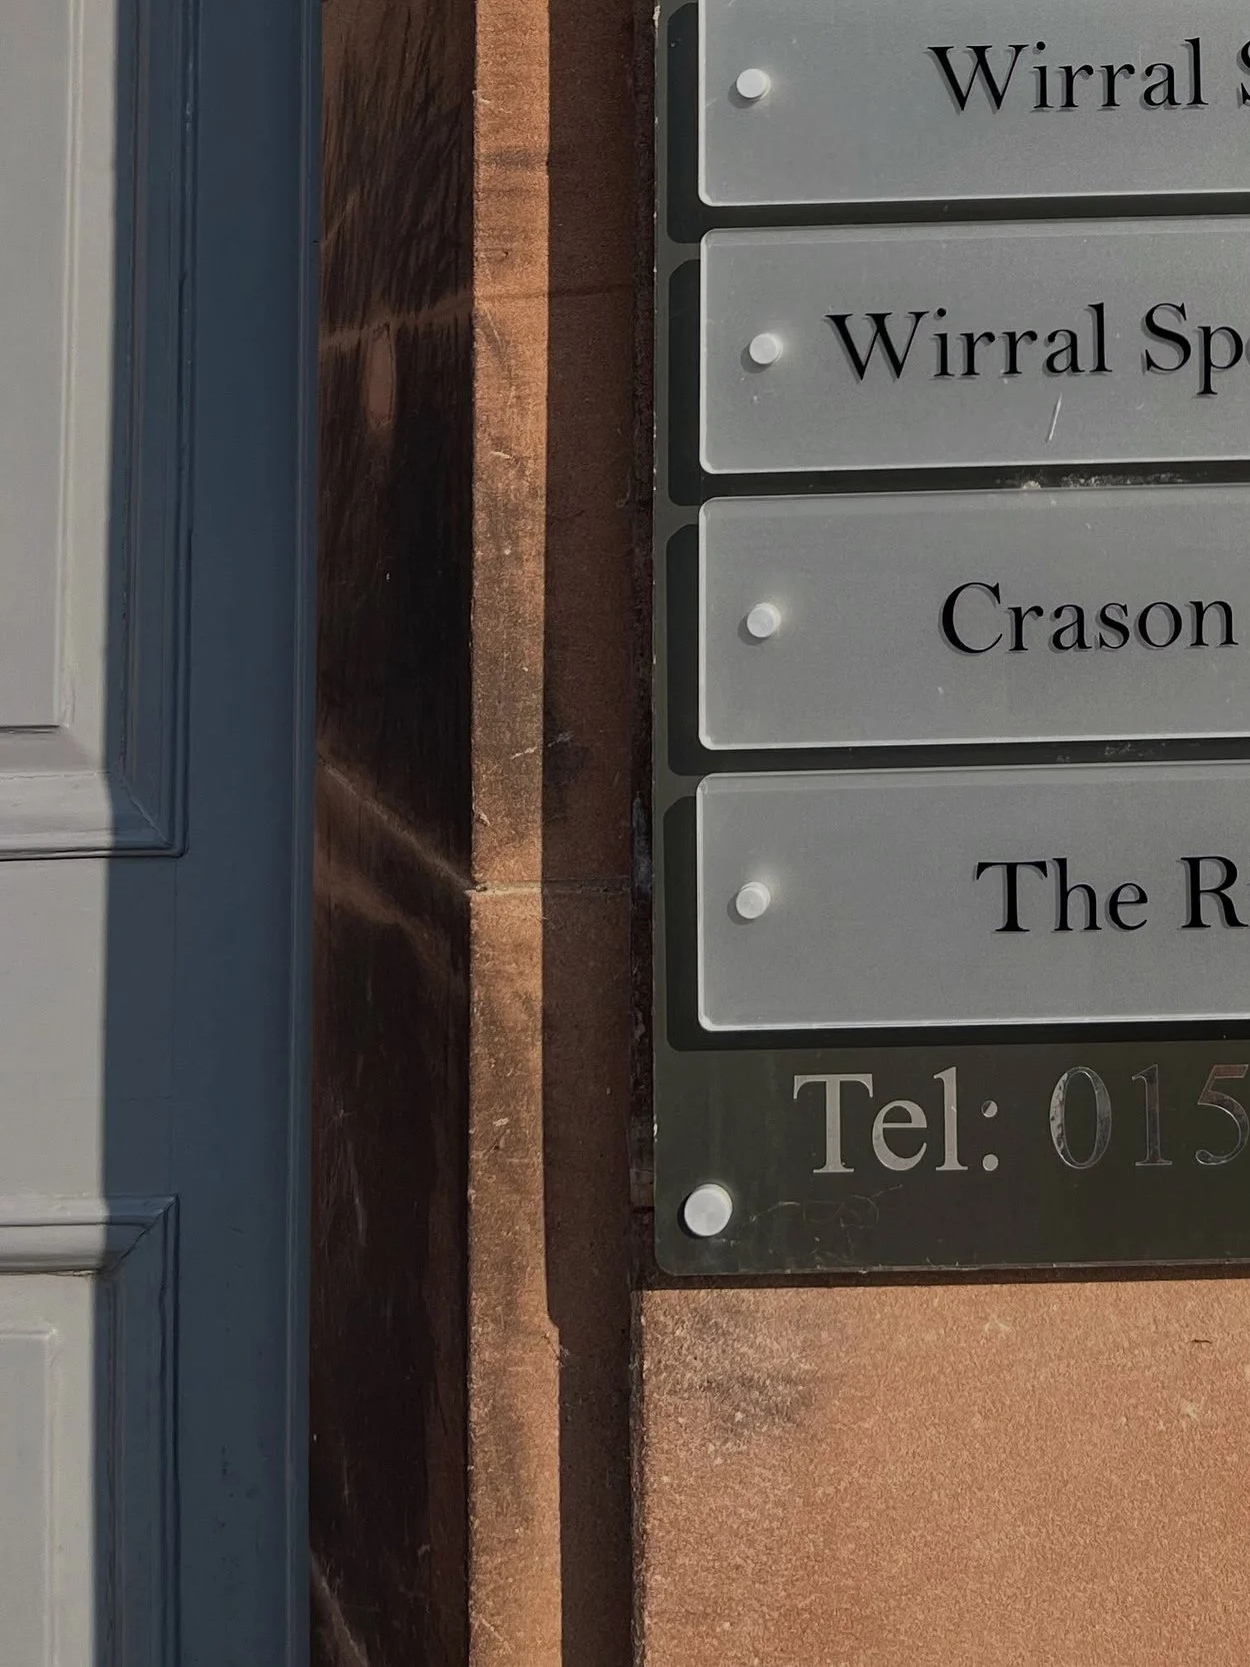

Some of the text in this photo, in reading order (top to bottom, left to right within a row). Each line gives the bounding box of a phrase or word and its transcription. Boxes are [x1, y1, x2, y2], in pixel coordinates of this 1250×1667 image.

[928, 38, 1208, 111] Wirral
[826, 302, 1112, 380] Wirral
[942, 583, 1238, 653] Crason
[977, 858, 1147, 932] The
[793, 1064, 1000, 1174] Tel:
